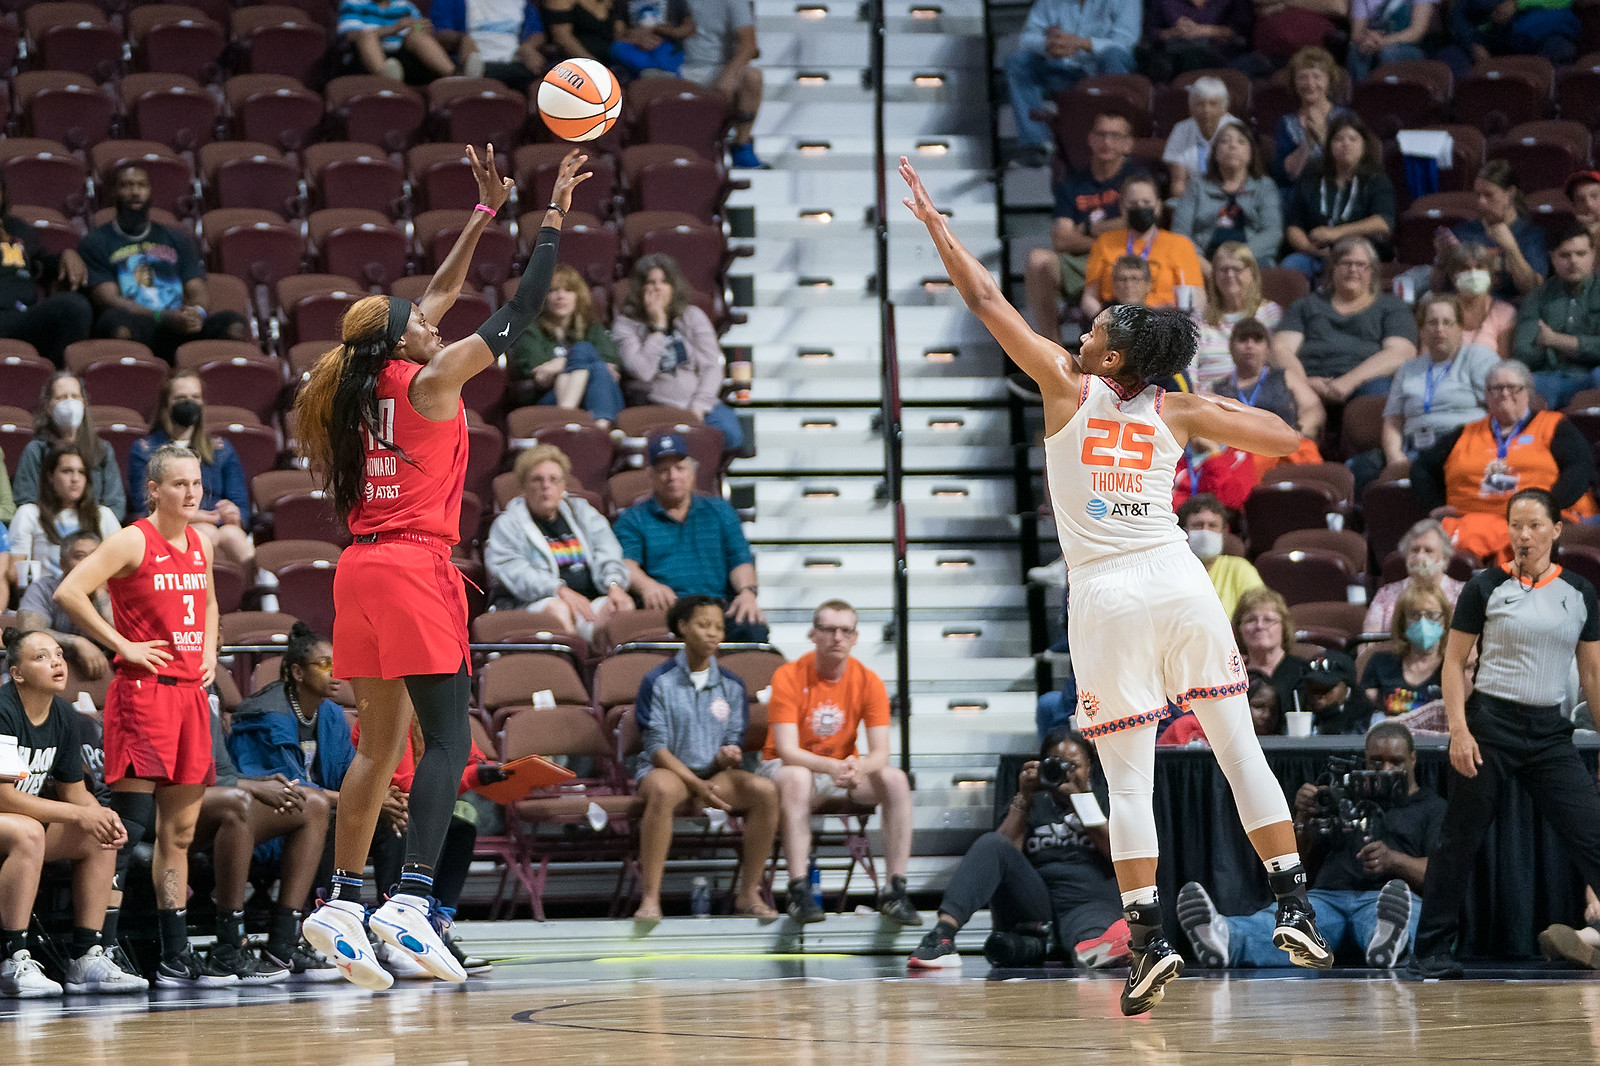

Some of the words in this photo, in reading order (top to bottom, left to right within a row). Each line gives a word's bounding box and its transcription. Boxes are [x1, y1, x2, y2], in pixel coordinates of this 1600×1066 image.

[1081, 417, 1156, 471] 25
[375, 484, 401, 499] AT&T
[1091, 472, 1143, 493] THOMAS
[1111, 502, 1151, 516] AT&T
[182, 594, 196, 626] 3
[172, 631, 204, 645] EMOR
